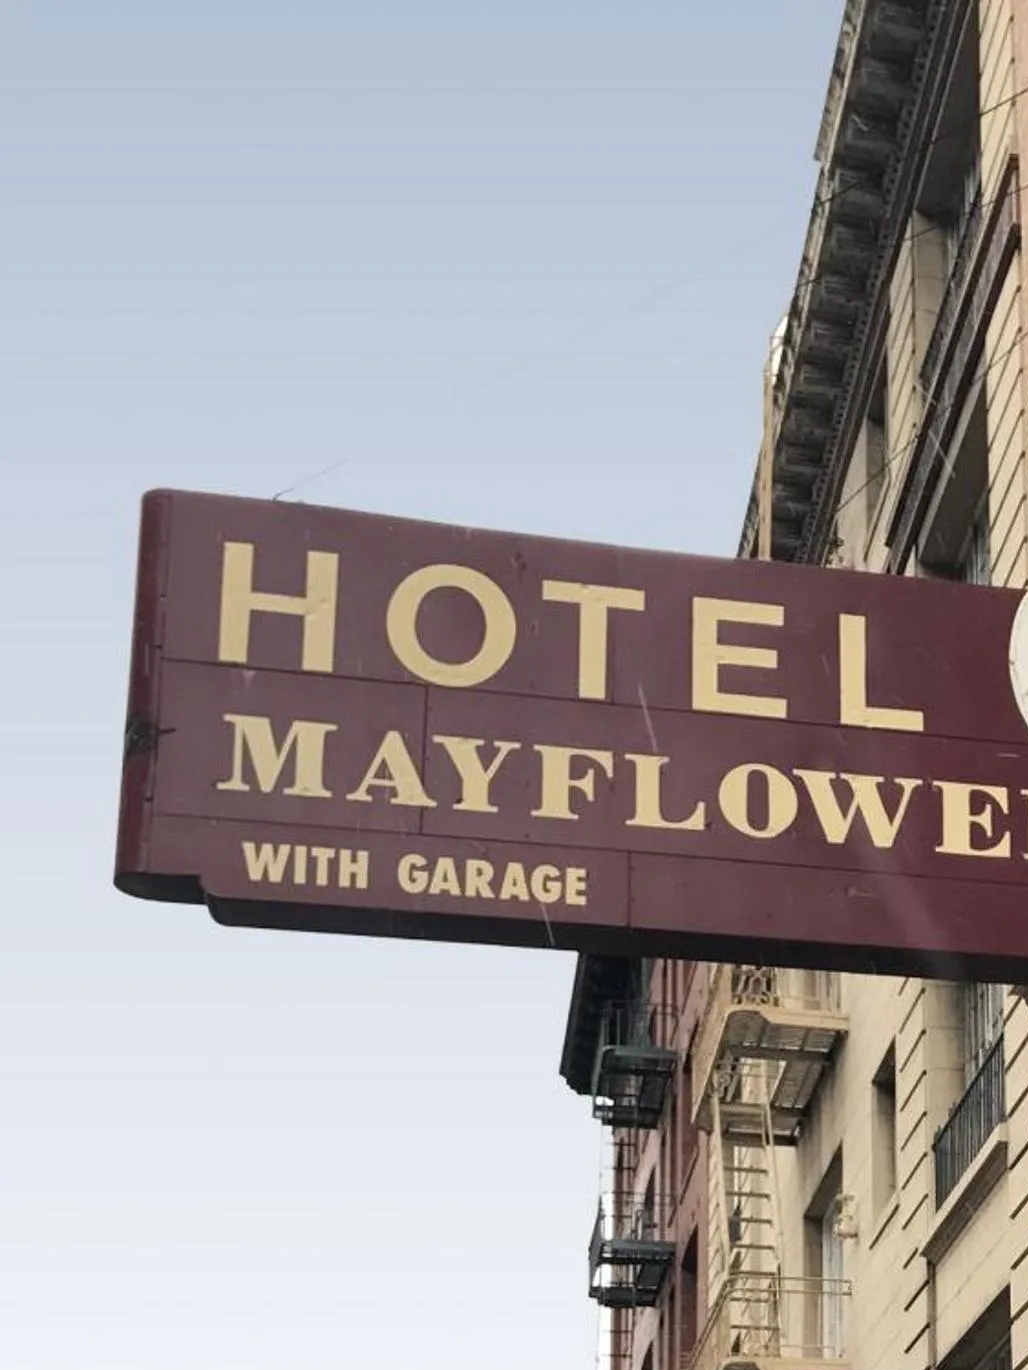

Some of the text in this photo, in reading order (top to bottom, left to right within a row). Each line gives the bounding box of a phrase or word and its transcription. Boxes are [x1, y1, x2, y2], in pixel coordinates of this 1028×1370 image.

[219, 542, 924, 732] HOTEL
[243, 842, 587, 906] WITH GARAGE
